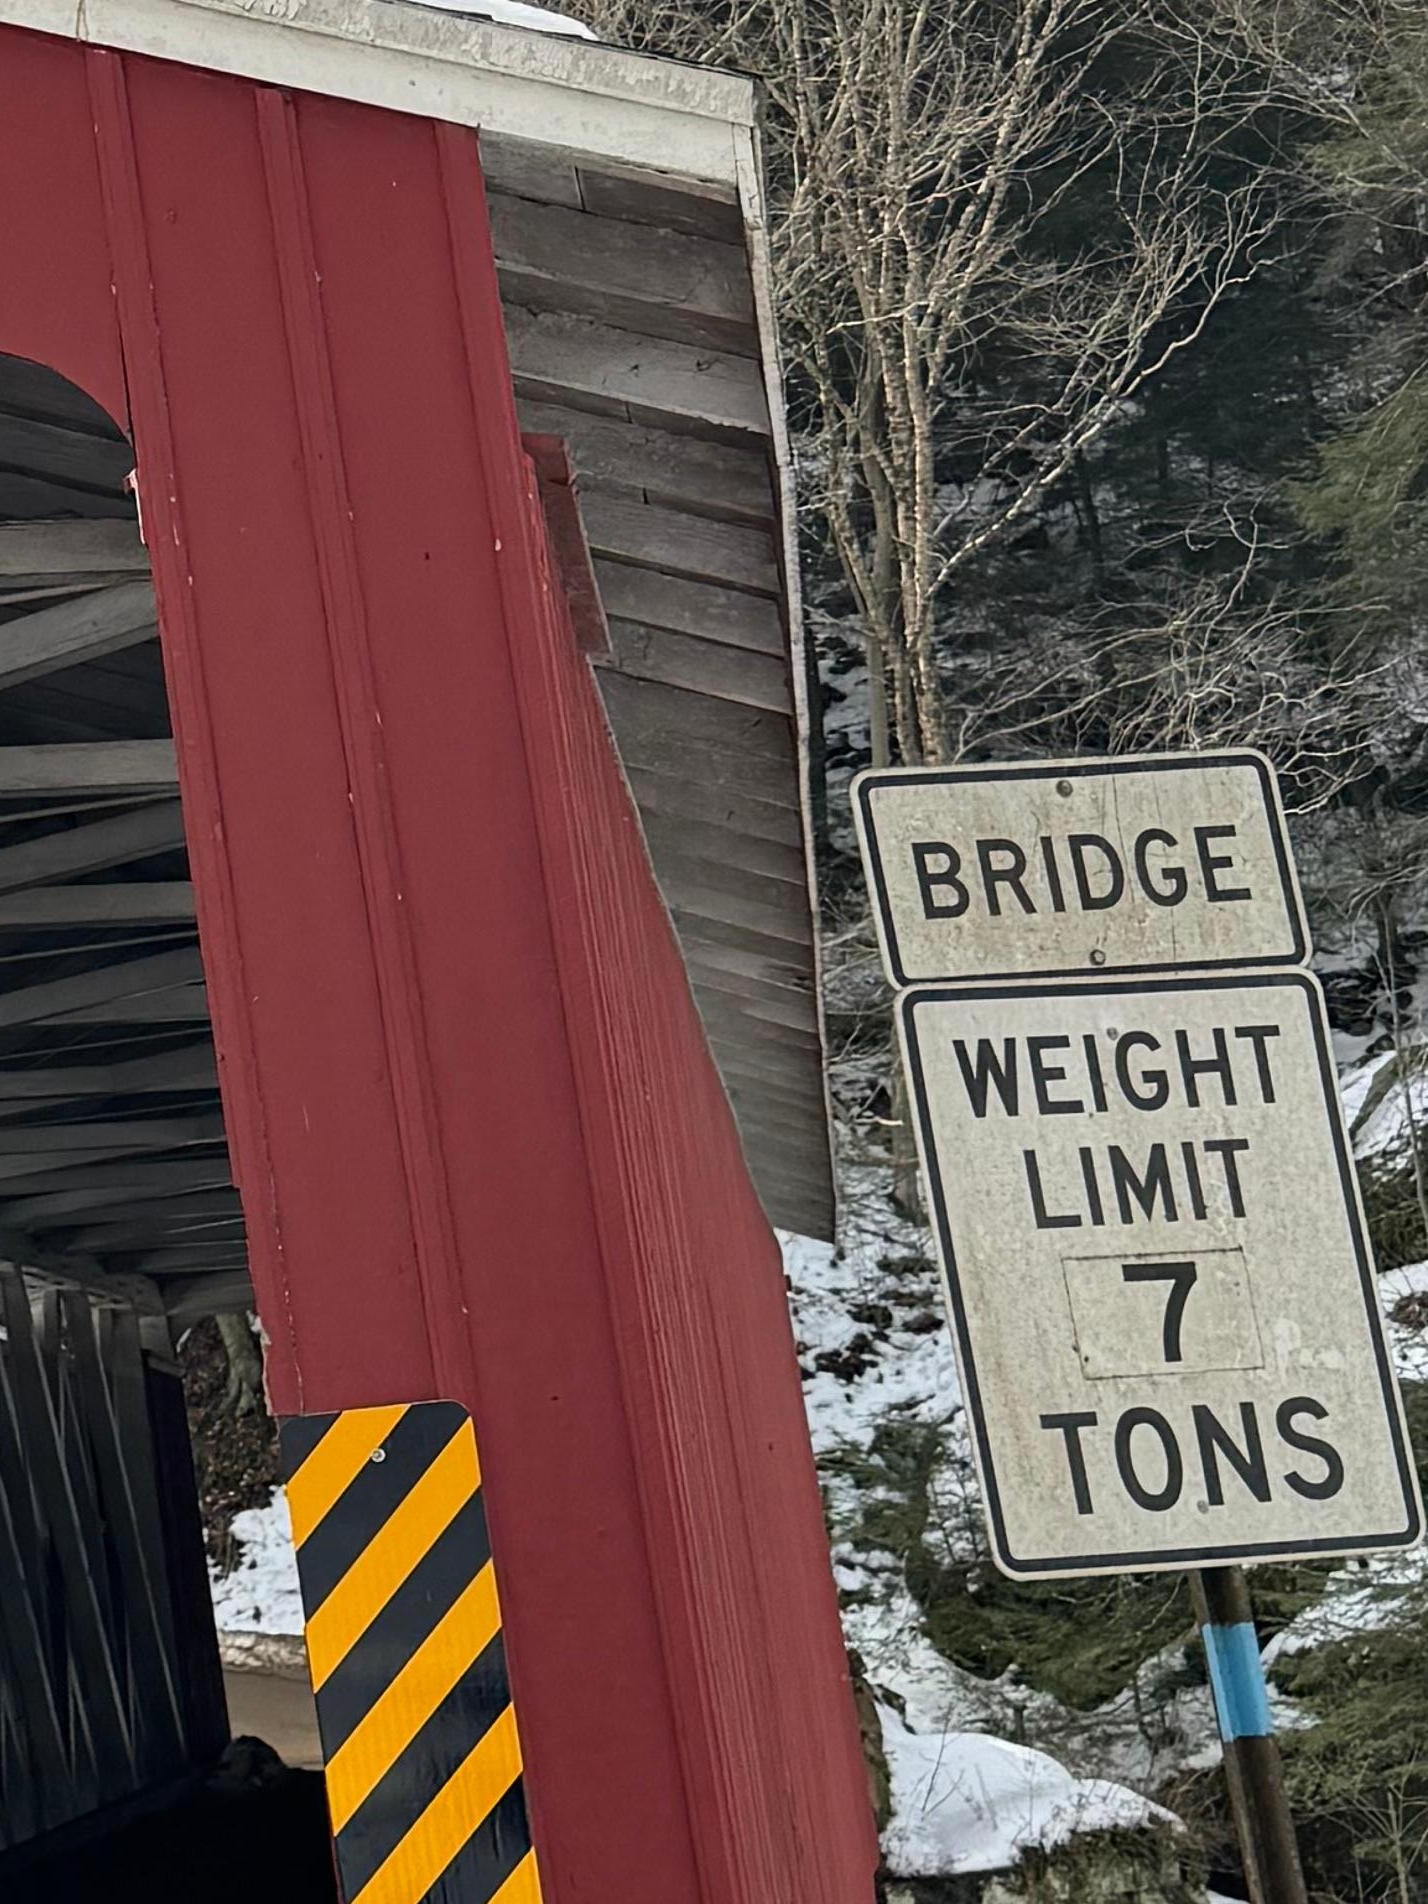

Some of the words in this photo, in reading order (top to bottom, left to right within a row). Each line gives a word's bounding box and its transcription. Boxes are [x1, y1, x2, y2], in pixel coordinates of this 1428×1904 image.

[911, 824, 1253, 921] BRIDGE
[952, 1024, 1281, 1119] WEIGHT
[1023, 1138, 1250, 1229] LIMIT
[1121, 1260, 1198, 1363] 7
[1039, 1396, 1346, 1515] TONS
